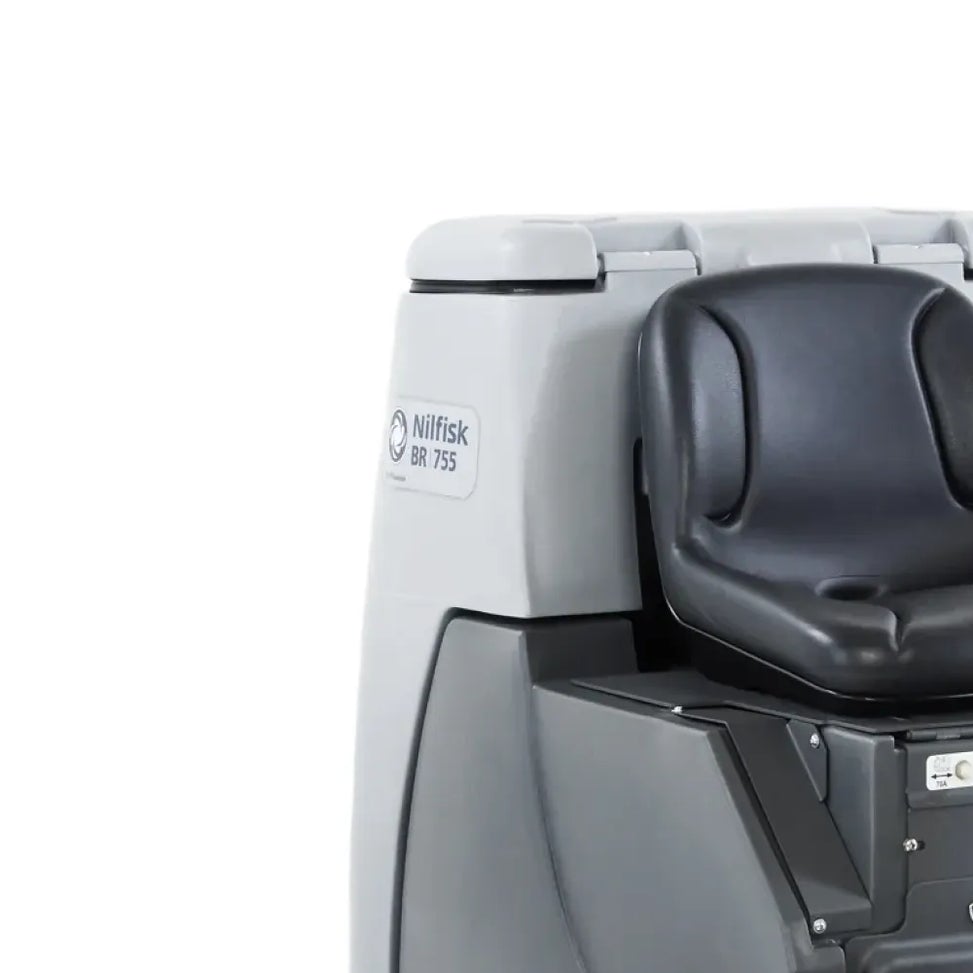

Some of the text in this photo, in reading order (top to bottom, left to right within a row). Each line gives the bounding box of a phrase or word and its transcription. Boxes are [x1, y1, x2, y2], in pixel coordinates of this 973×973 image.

[412, 413, 469, 446] Nilfisk
[410, 445, 457, 472] BR 755
